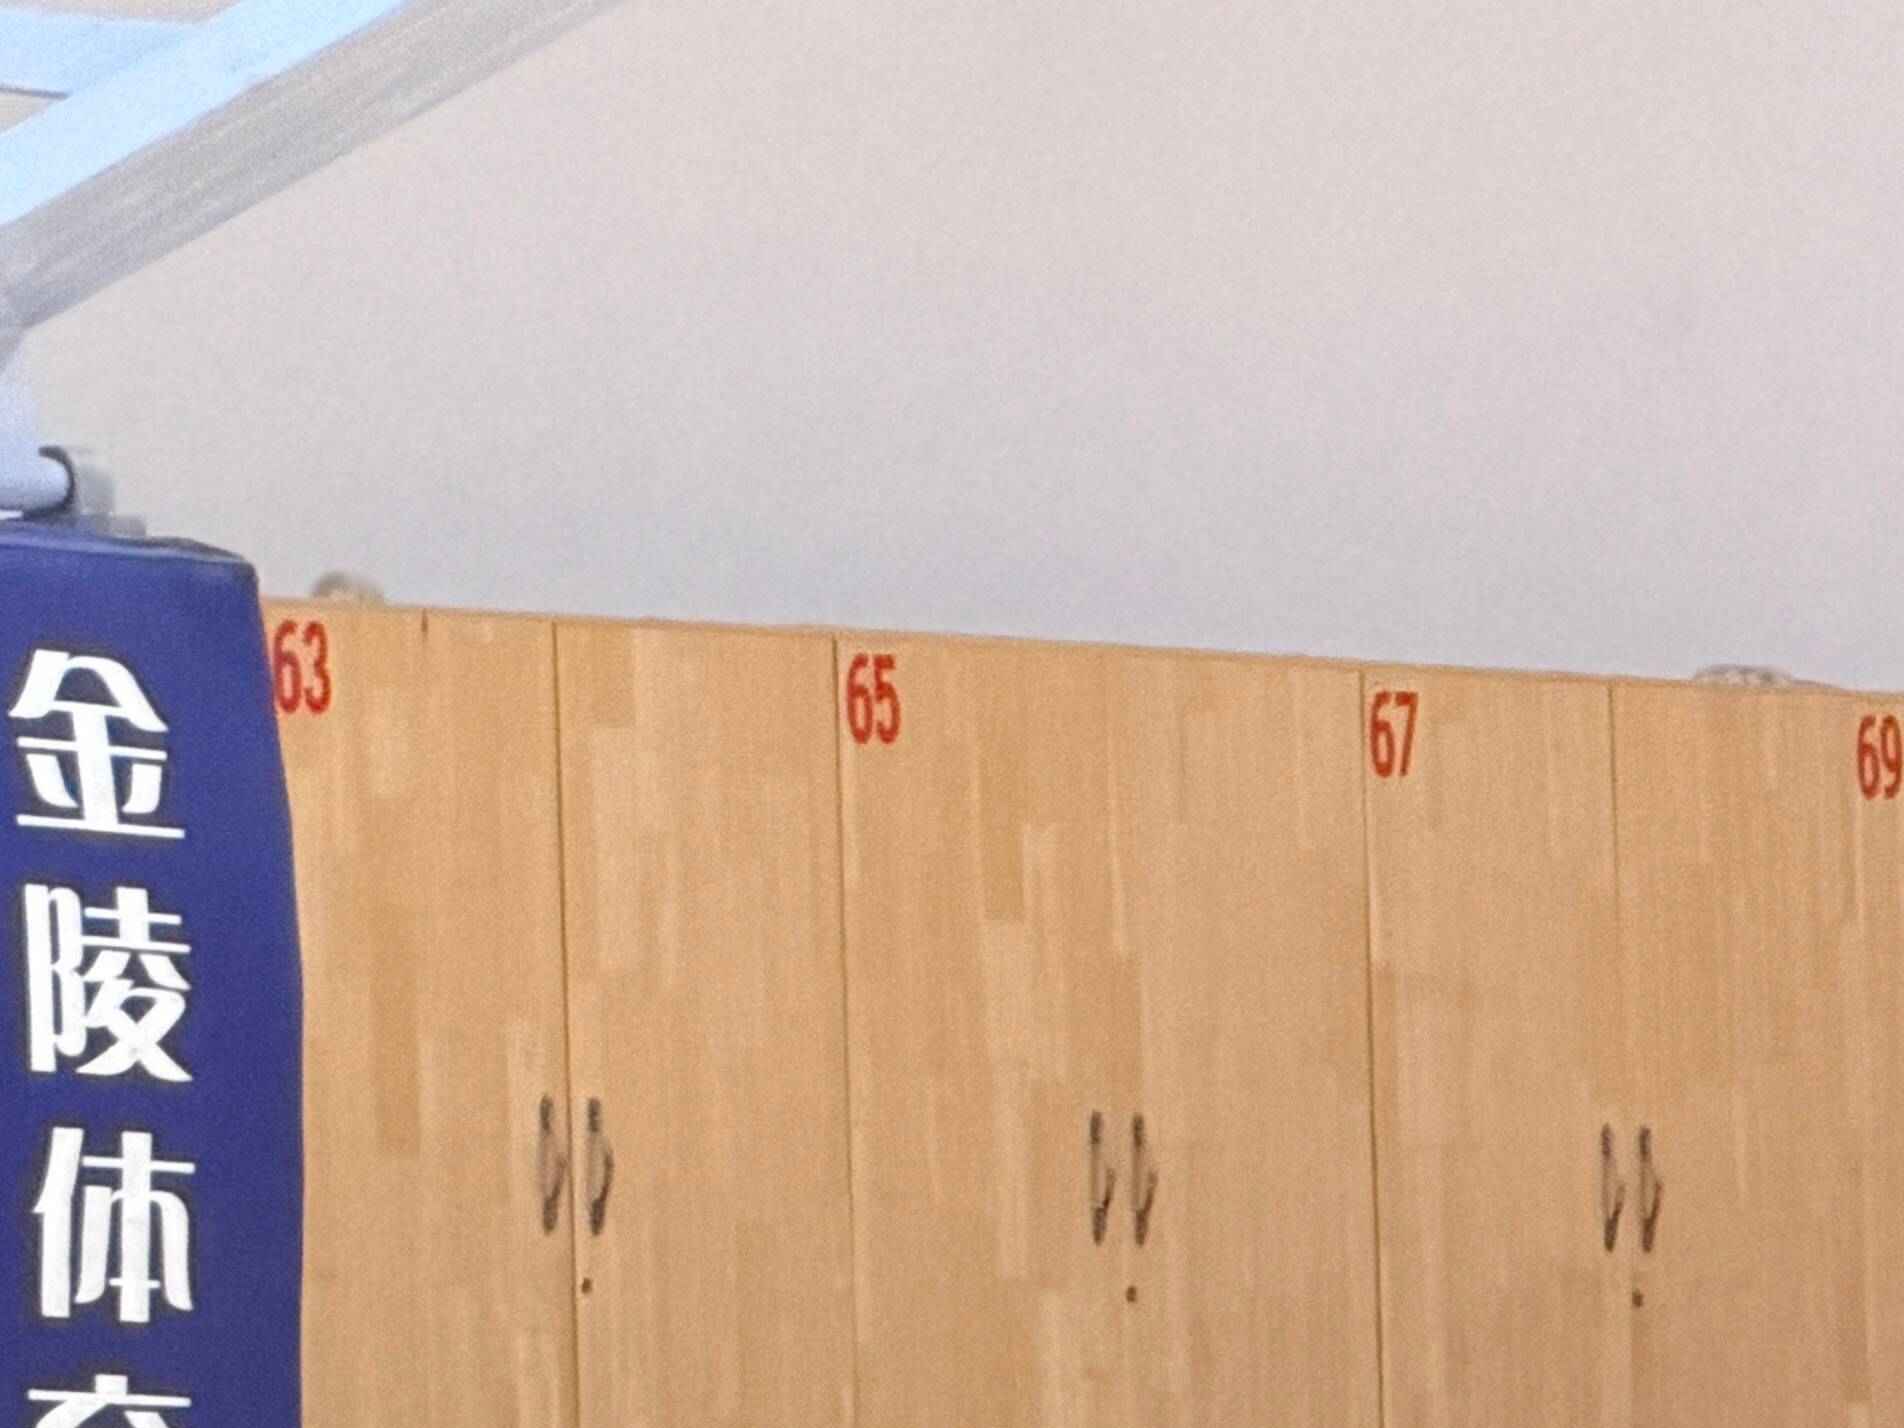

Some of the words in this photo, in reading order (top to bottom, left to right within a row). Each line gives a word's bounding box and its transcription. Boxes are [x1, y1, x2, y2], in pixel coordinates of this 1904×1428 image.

[274, 619, 332, 715] 63
[846, 653, 901, 745] 65
[1370, 691, 1419, 779] 67
[1856, 714, 1903, 800] 69
